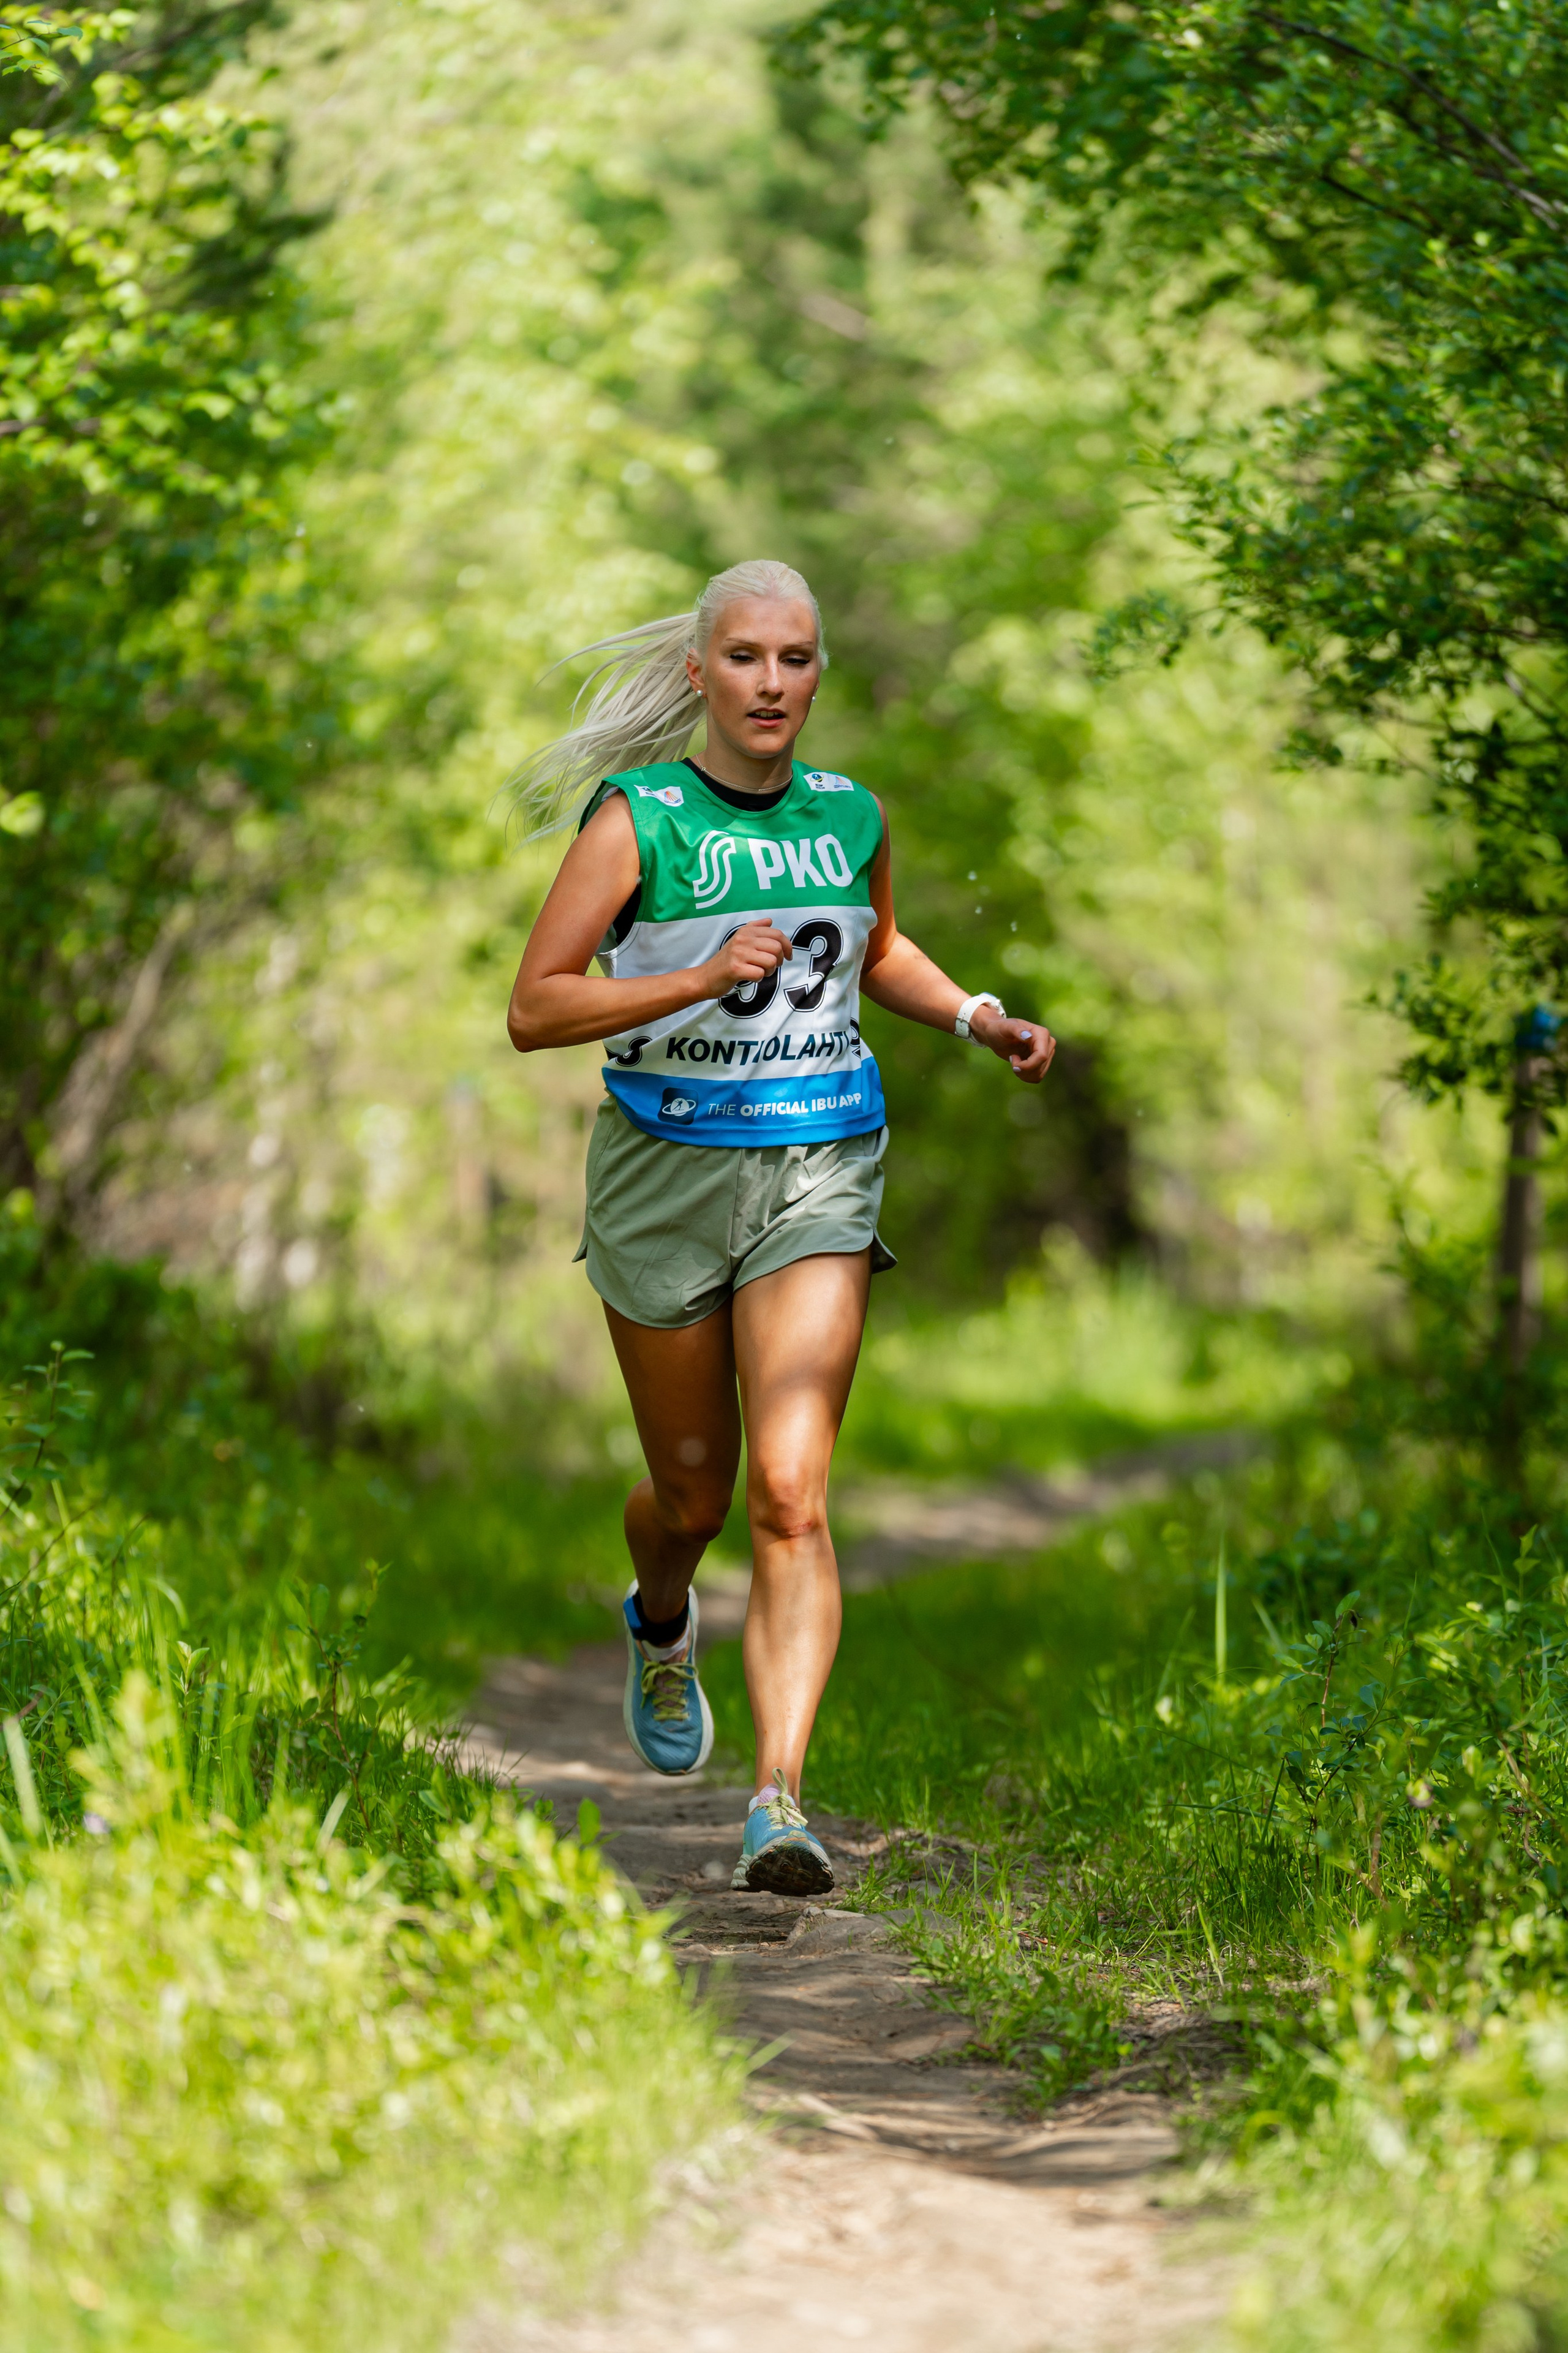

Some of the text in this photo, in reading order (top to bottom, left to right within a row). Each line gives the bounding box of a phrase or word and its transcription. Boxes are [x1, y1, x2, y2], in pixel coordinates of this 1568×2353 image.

[747, 834, 853, 889] PKO
[708, 1093, 862, 1117] THE OFFICIAL IBU APP
